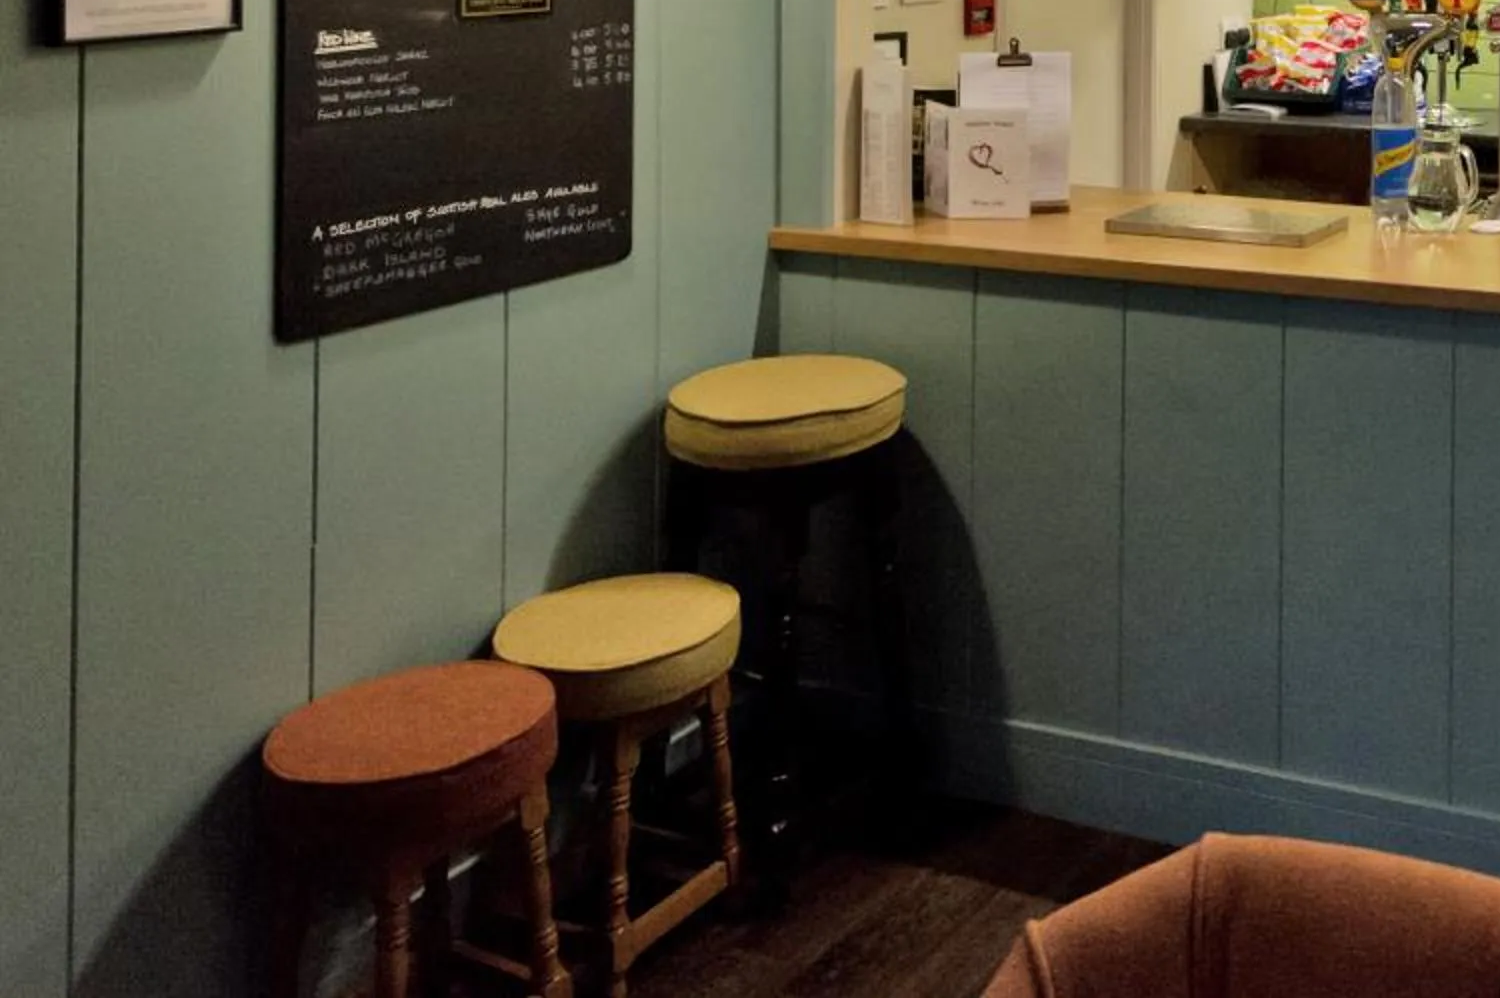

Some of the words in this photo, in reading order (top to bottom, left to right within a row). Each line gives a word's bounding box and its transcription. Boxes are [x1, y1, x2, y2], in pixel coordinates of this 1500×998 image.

[312, 225, 324, 242] A
[328, 213, 401, 237] SELECTION
[405, 207, 423, 225] OF
[545, 182, 599, 199] AVAILABLE
